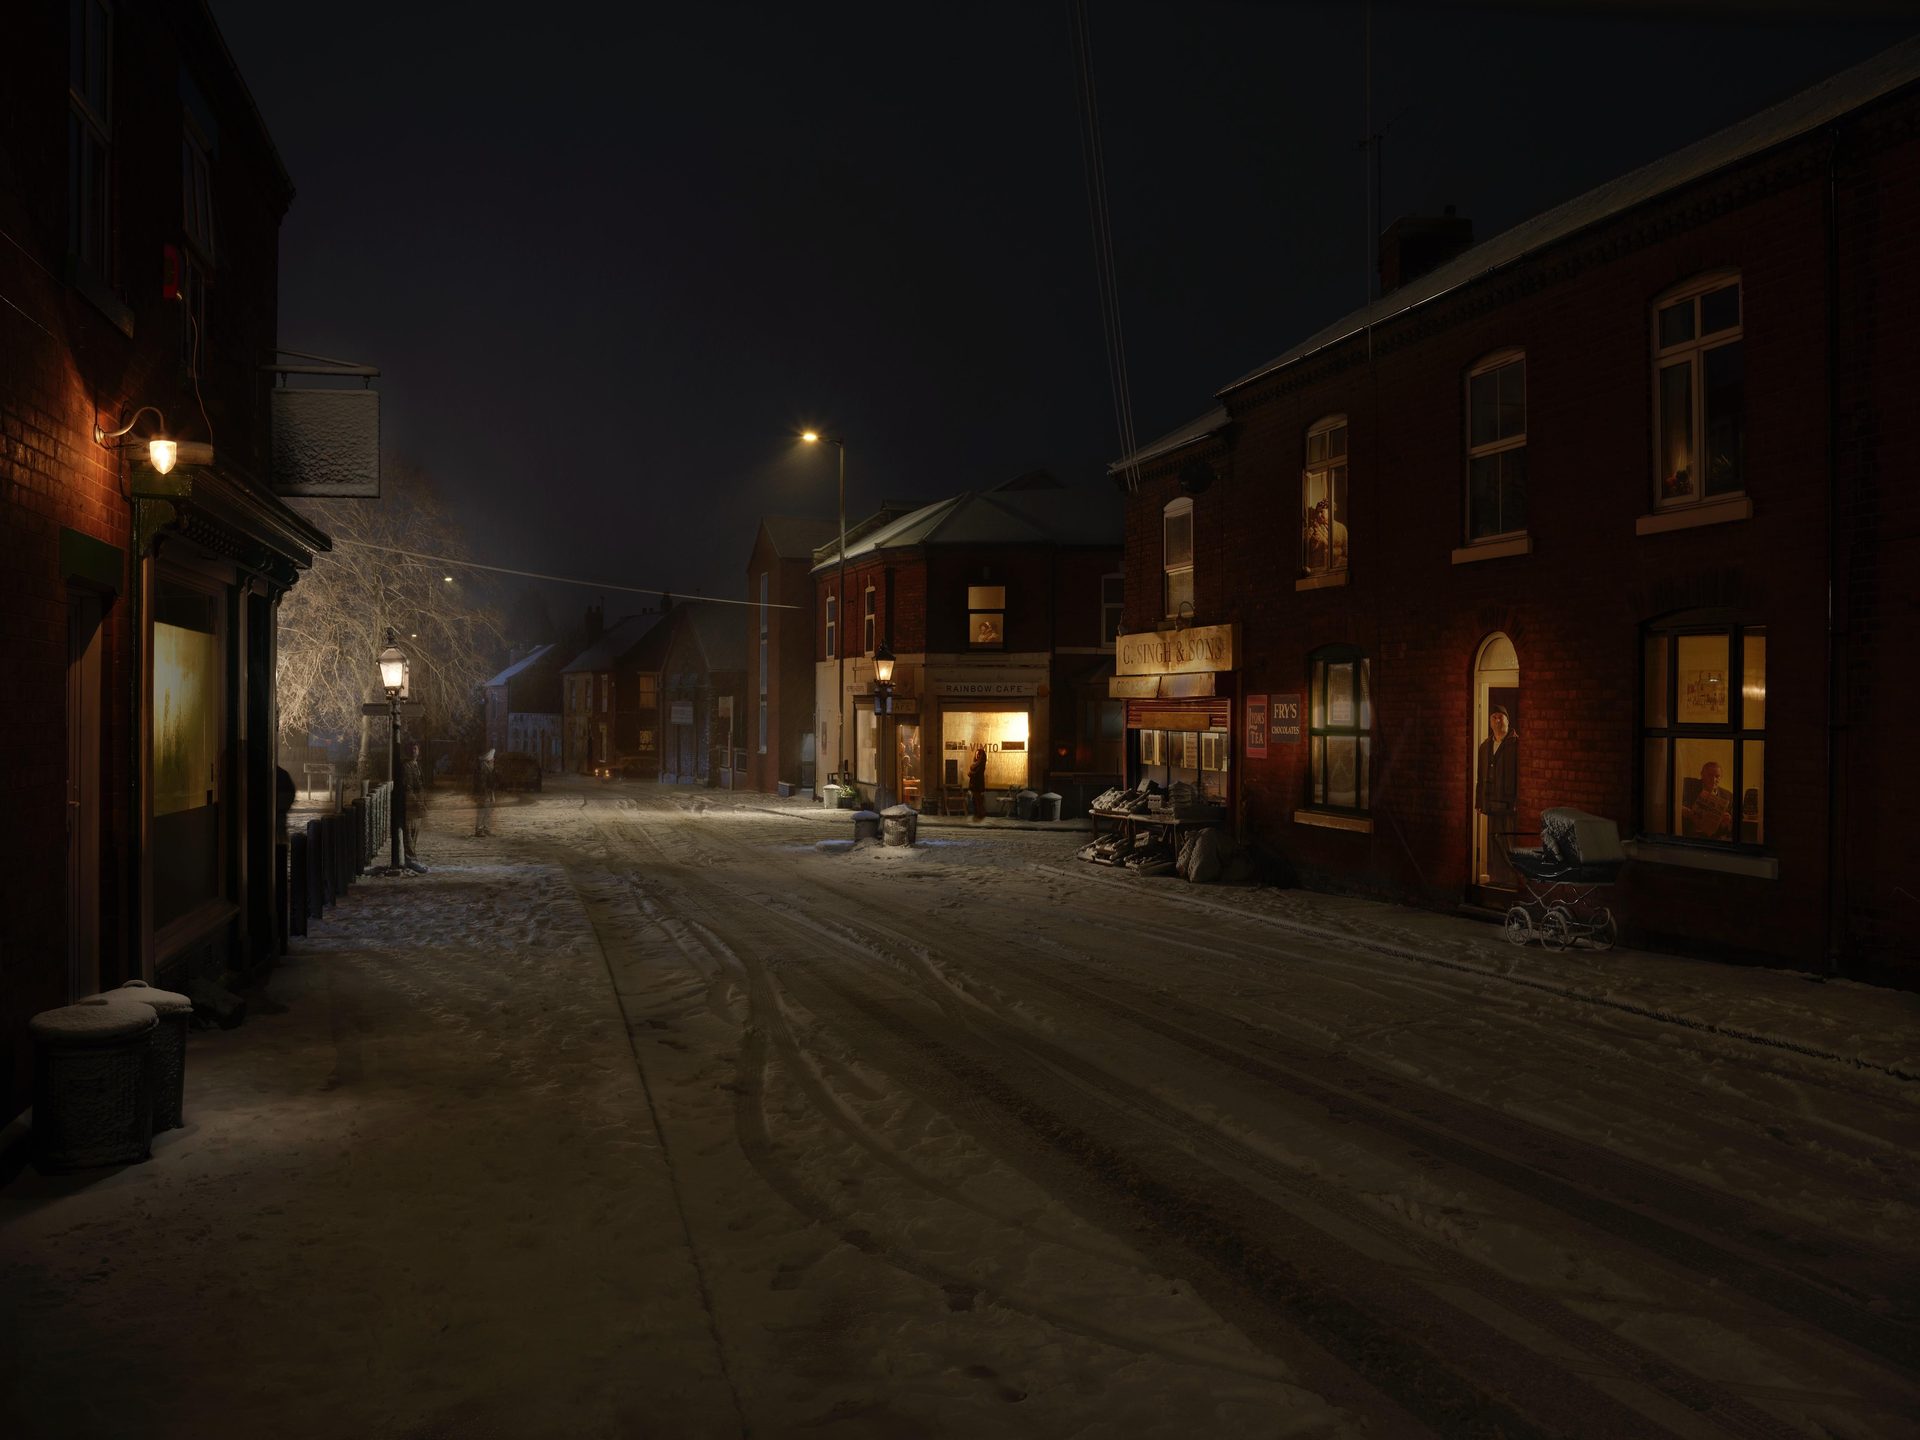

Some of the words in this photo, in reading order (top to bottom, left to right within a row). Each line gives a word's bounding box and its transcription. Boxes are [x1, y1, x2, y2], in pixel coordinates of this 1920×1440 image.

[1136, 641, 1171, 665] SINGH
[1176, 640, 1185, 663] &
[1188, 637, 1223, 662] SONS
[946, 685, 993, 693] RAINBOW
[996, 685, 1023, 693] CAFE
[1274, 703, 1297, 719] FRY'S
[1271, 726, 1300, 735] CHOCOLATES
[1251, 731, 1265, 745] TEA
